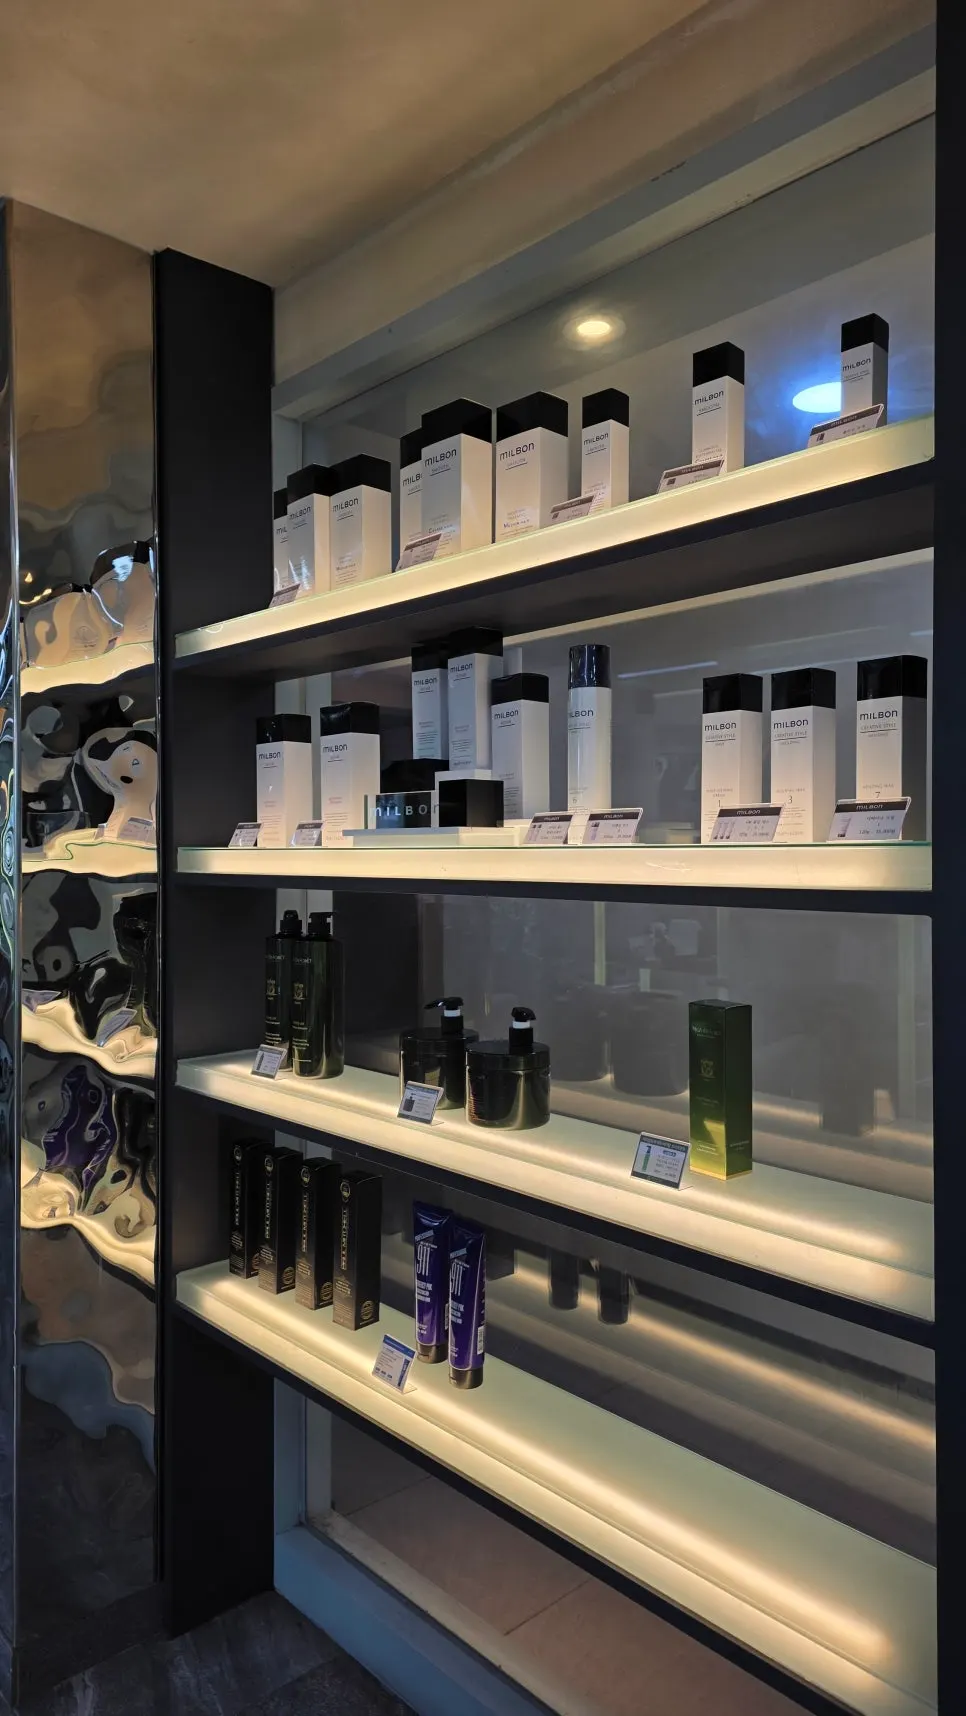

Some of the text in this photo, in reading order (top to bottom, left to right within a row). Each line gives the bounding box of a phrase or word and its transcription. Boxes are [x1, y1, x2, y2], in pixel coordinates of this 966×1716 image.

[860, 709, 898, 721] MILBON
[704, 722, 737, 731] MILBON
[773, 719, 809, 730] MILBON
